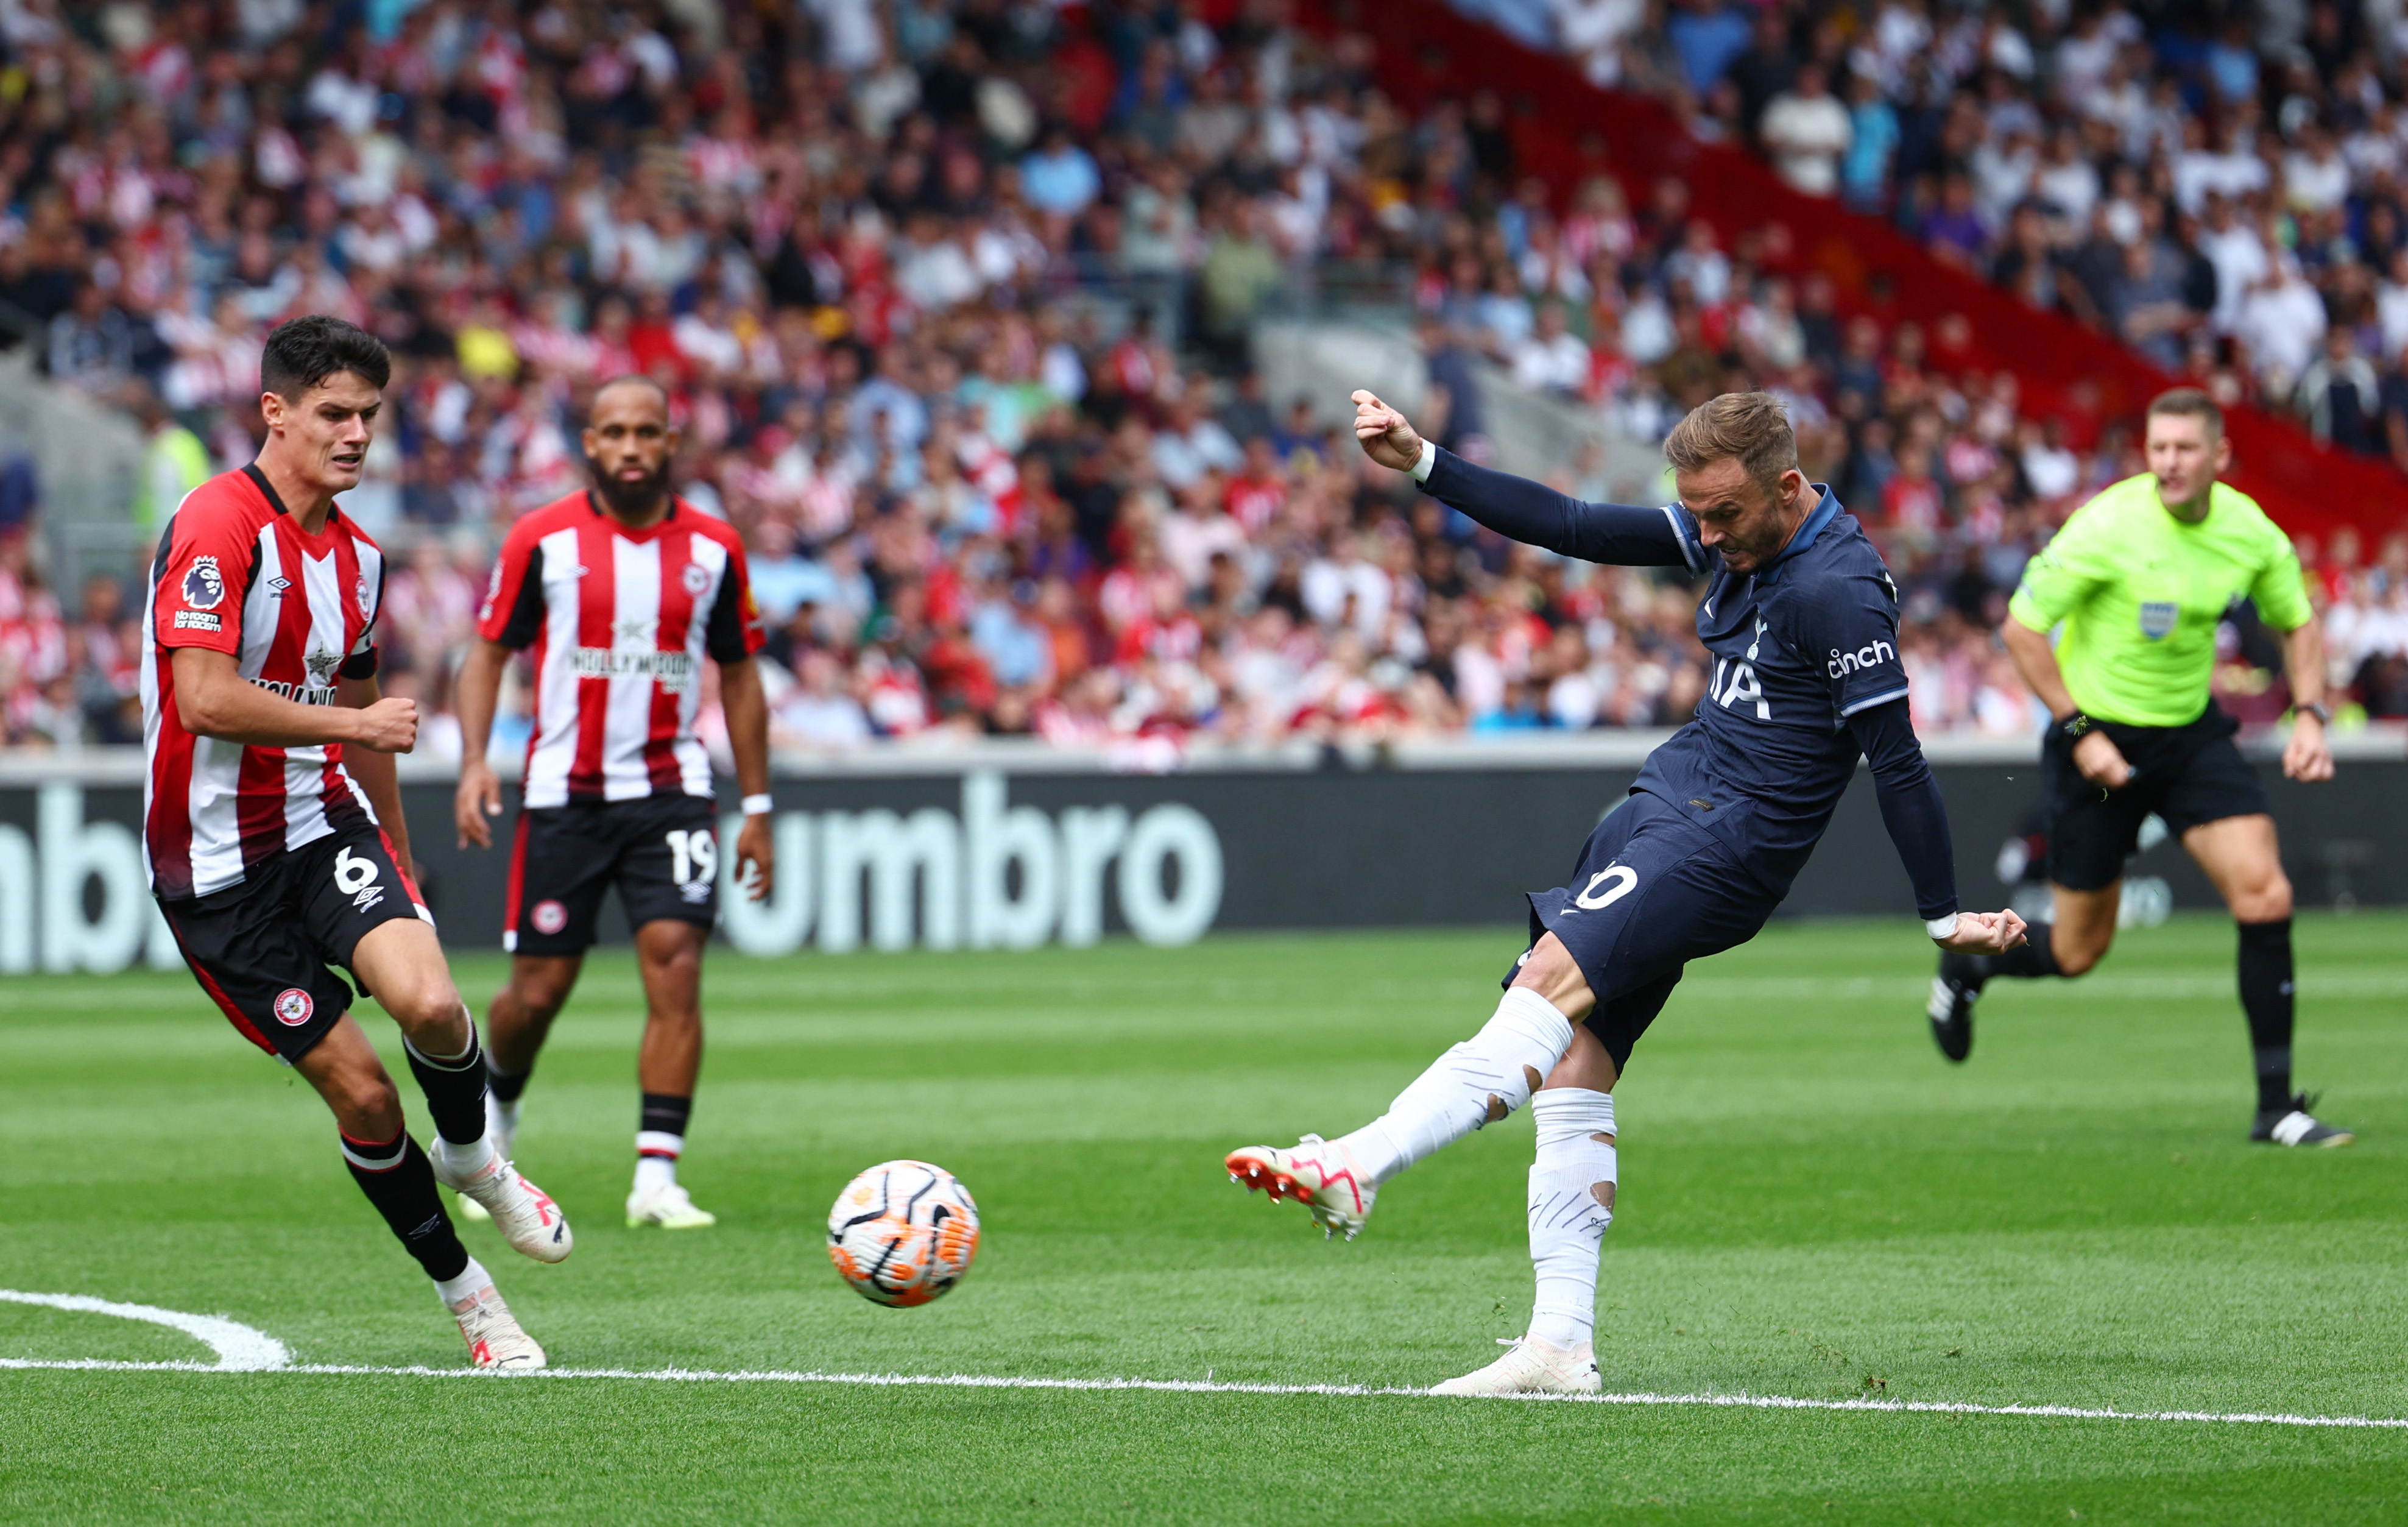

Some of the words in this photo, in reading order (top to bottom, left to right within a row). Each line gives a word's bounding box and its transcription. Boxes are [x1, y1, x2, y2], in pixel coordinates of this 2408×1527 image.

[174, 610, 189, 621] No
[189, 611, 219, 623] room
[1827, 640, 1894, 679] cinch
[334, 845, 379, 895] 6
[665, 829, 719, 885] 19
[719, 769, 1226, 958] umbro
